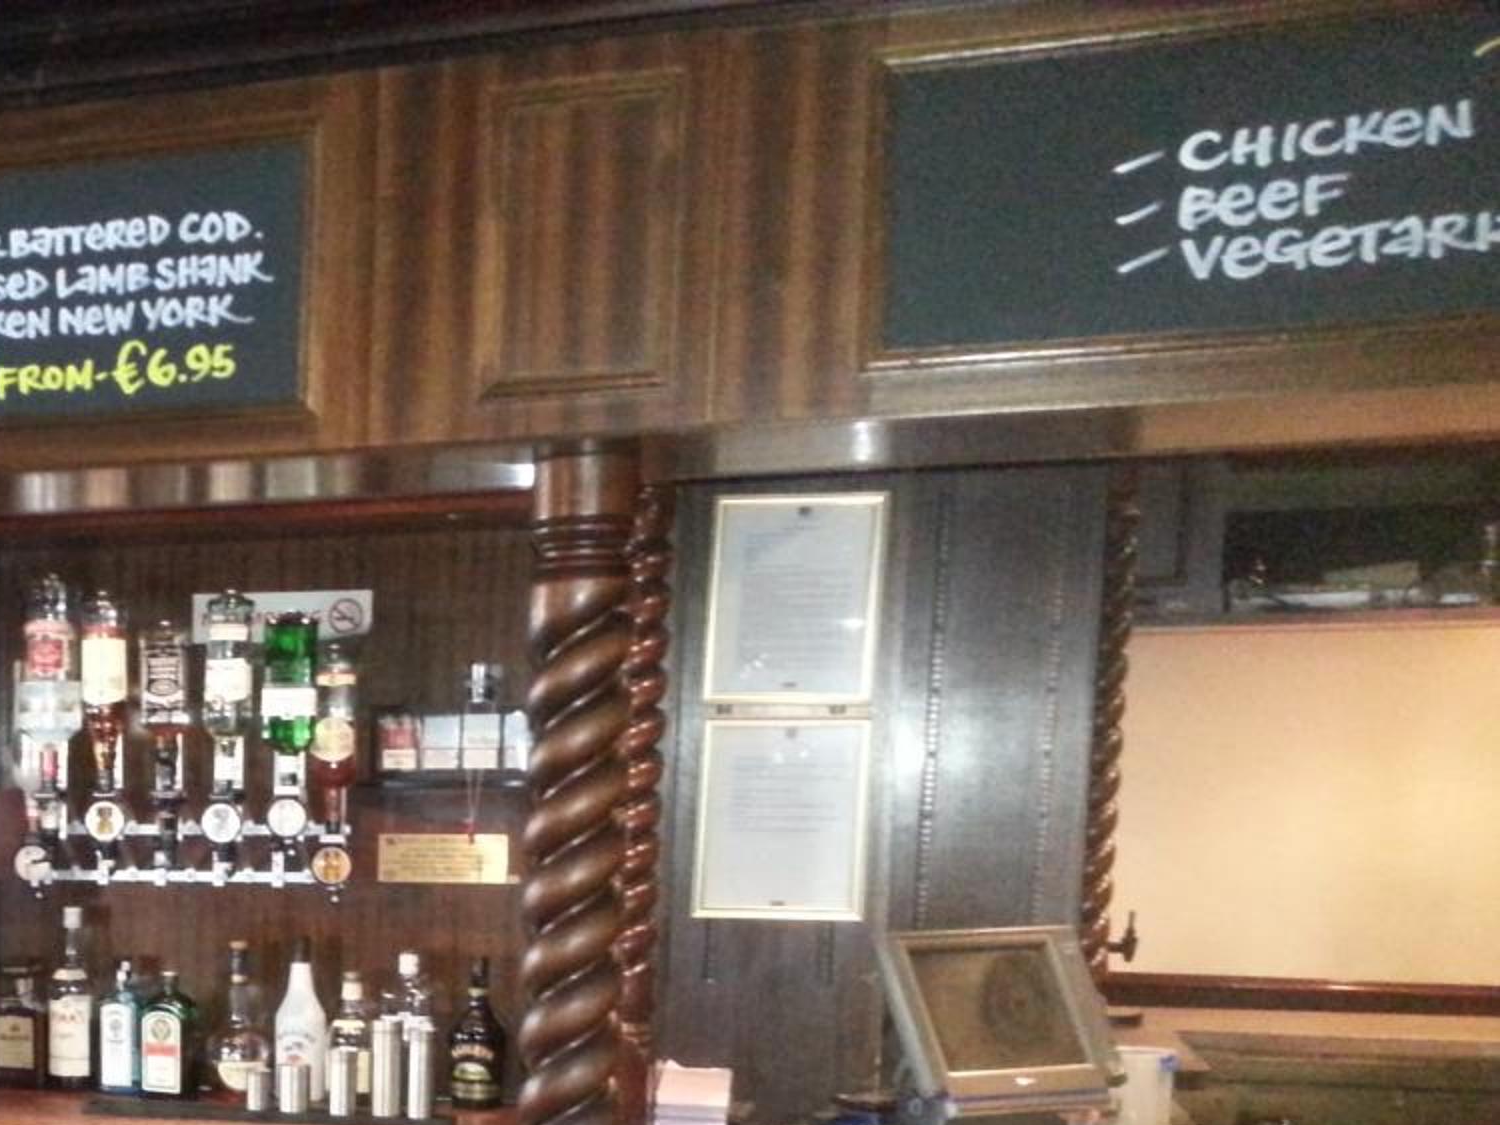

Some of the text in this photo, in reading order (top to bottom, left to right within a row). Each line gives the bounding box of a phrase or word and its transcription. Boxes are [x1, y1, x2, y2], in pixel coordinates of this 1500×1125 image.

[1177, 99, 1475, 172] CHICKEN
[1176, 172, 1352, 232] BEEF
[9, 214, 171, 259] BATTERED
[1181, 211, 1500, 281] VEGETARI
[55, 261, 152, 300] LAMB
[154, 251, 274, 291] SHANK
[58, 302, 135, 337] NEW
[140, 294, 255, 331] YORK
